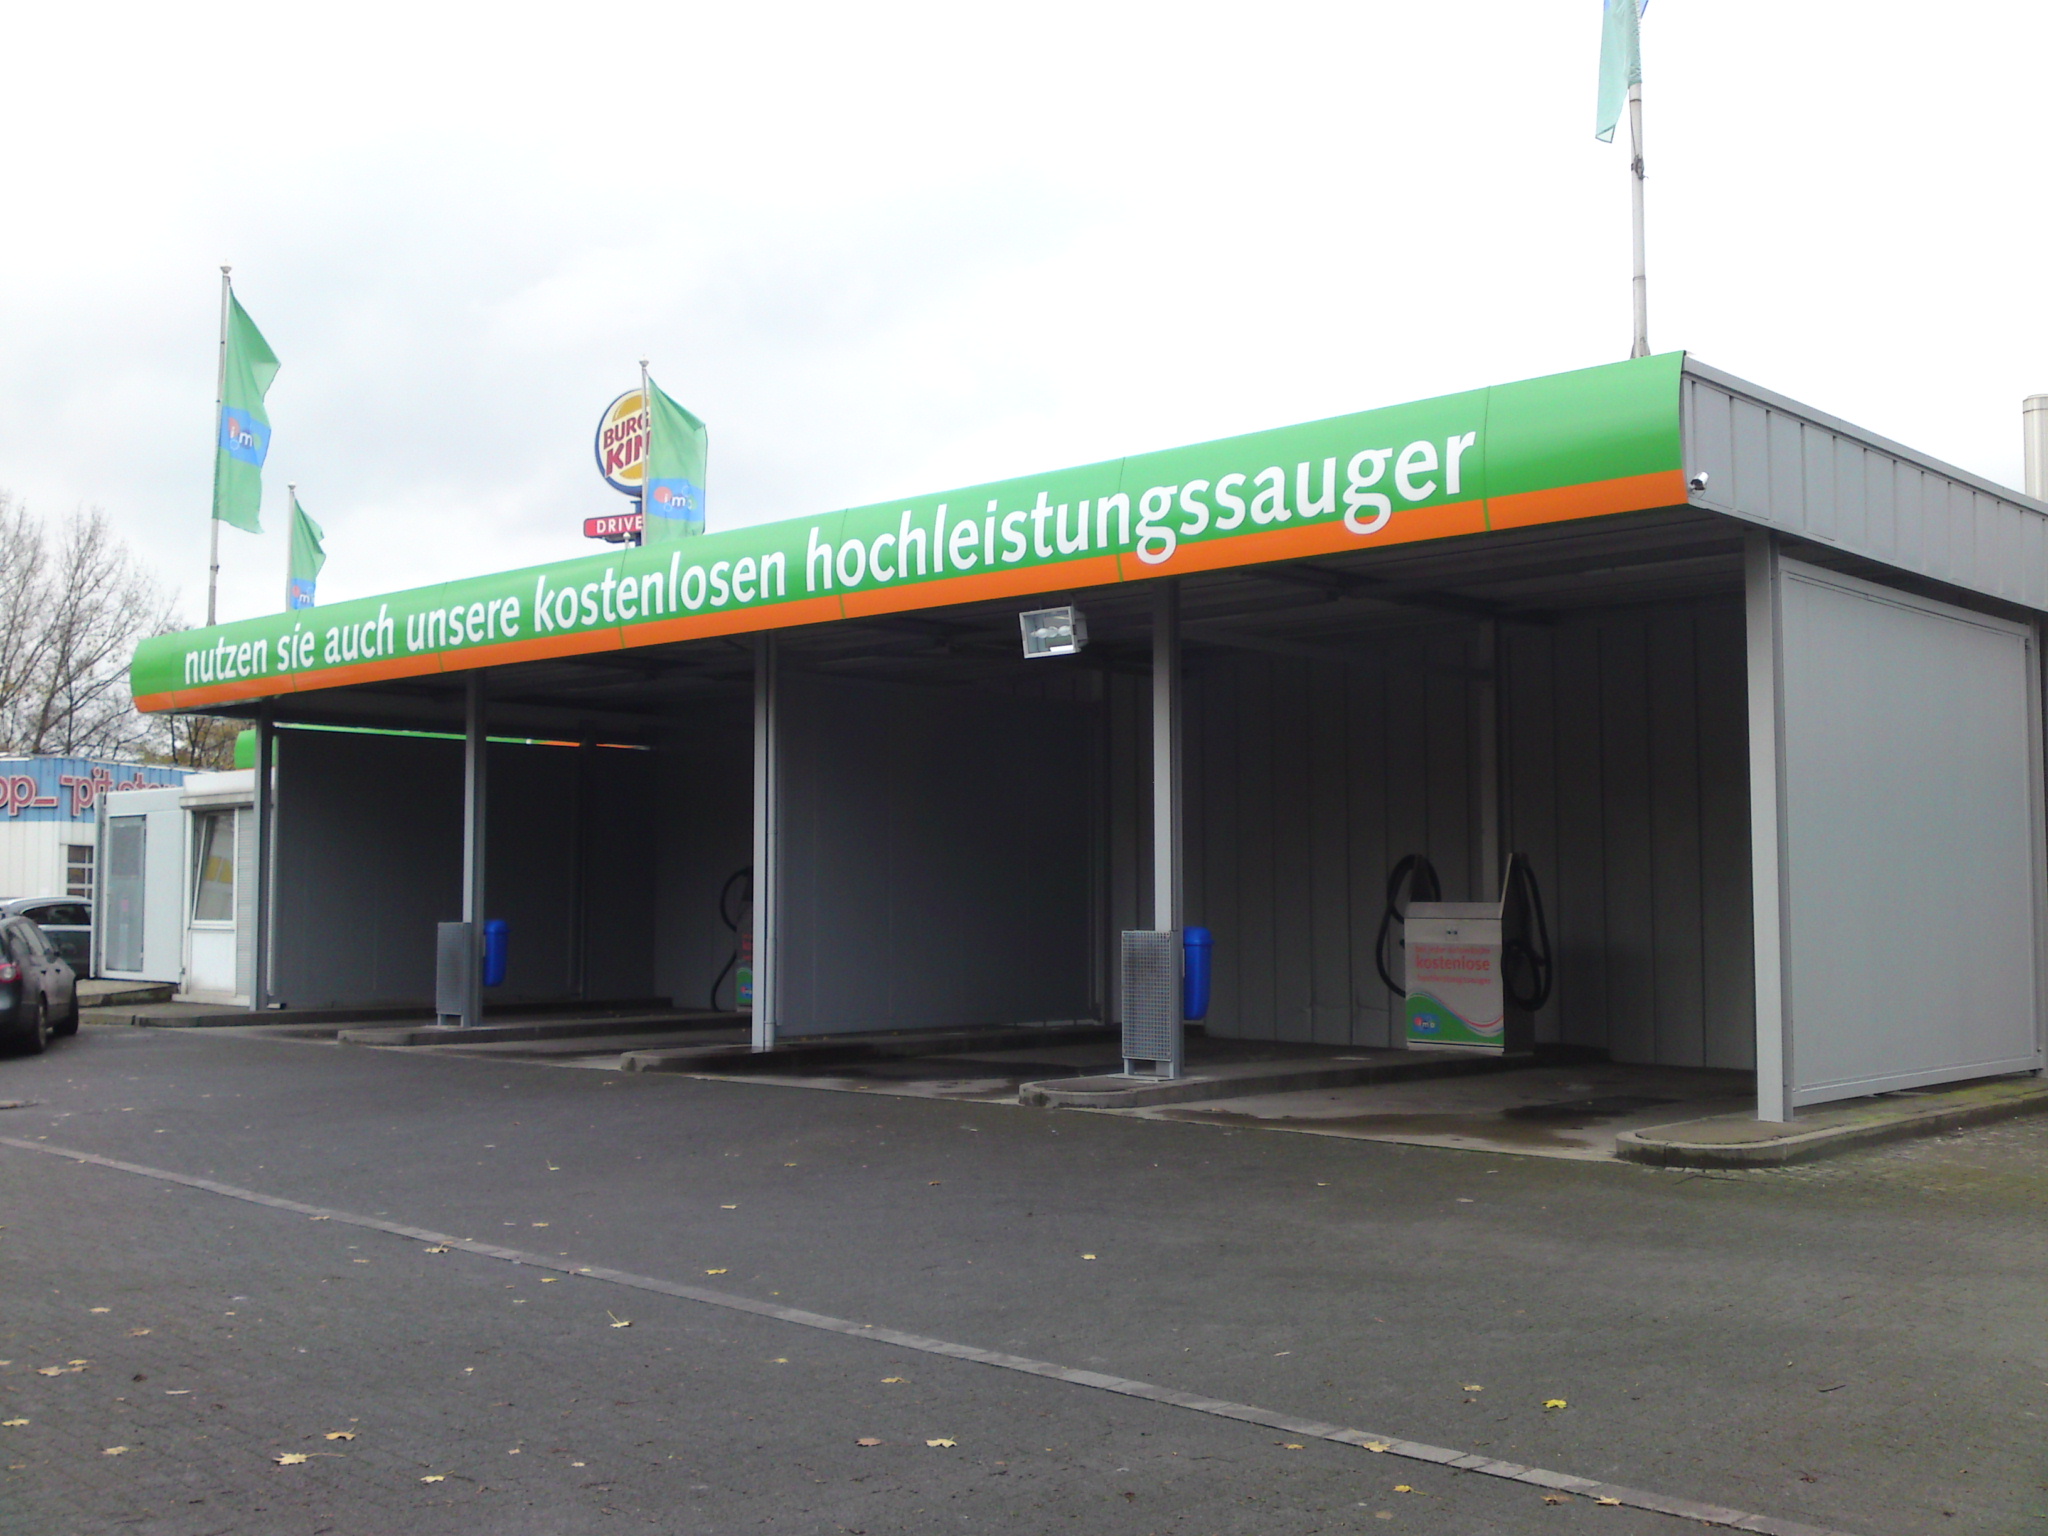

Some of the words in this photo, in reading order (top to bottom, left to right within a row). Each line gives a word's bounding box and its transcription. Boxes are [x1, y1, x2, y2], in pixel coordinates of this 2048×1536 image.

[184, 636, 268, 685] nutzen
[276, 622, 316, 672] sie
[324, 603, 395, 665] auch
[406, 596, 521, 652] unsere
[534, 550, 786, 633] kostenlosen
[805, 431, 1477, 592] hochleistungssauger
[596, 516, 643, 534] DRIVE
